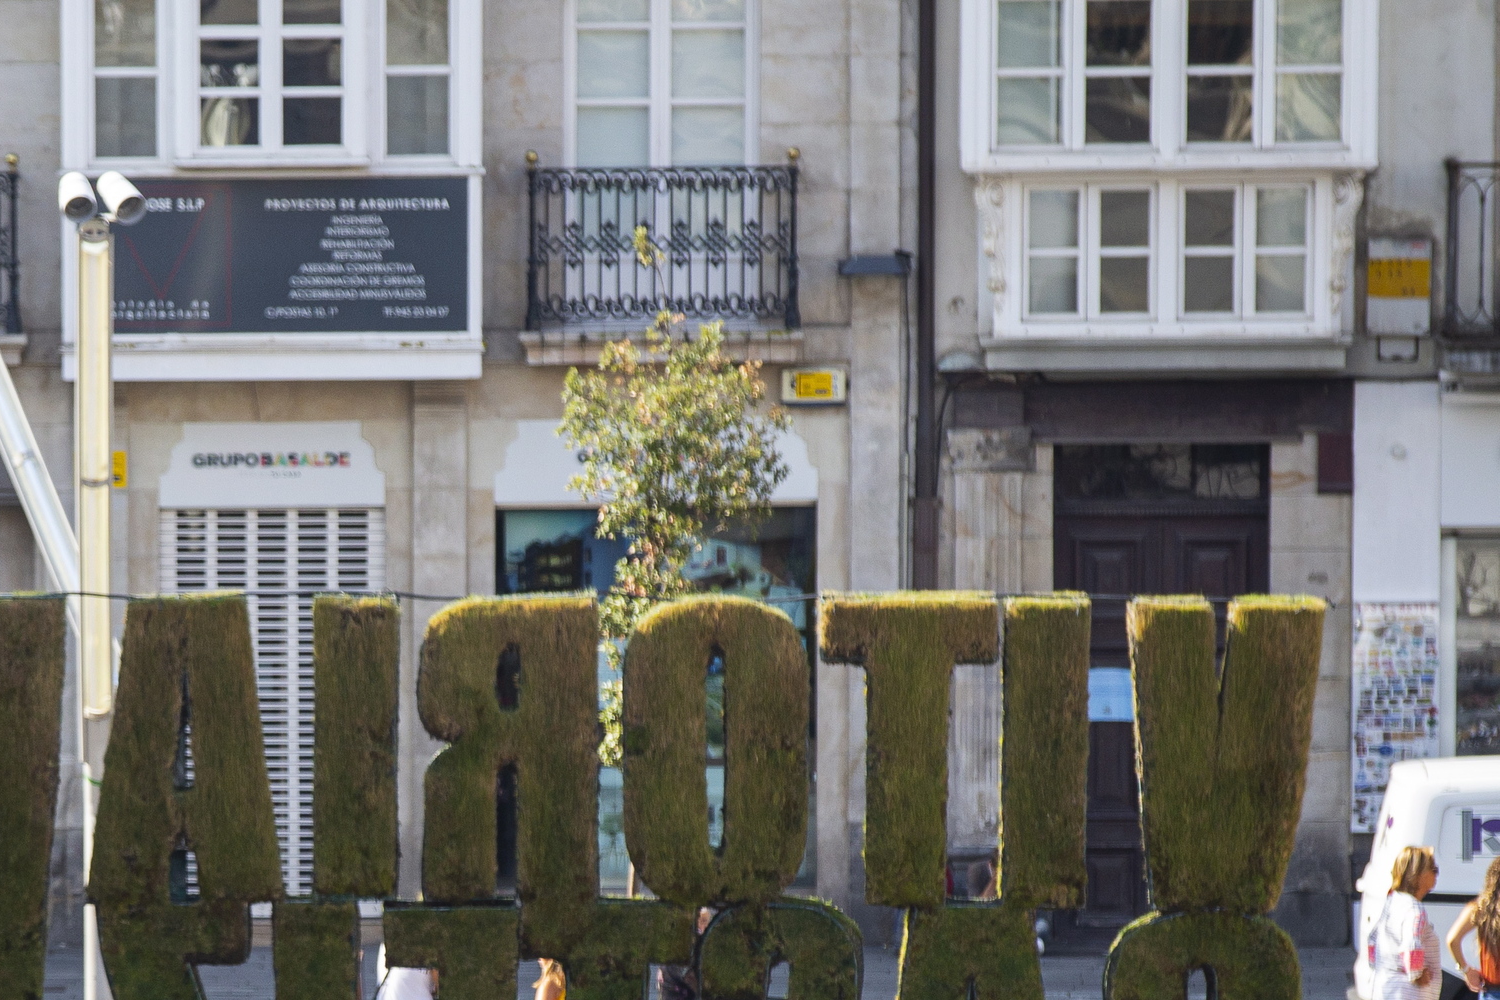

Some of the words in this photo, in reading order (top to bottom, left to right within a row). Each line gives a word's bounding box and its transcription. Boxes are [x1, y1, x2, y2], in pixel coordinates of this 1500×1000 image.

[264, 198, 336, 211] PROYECTOS
[338, 198, 356, 211] DE
[358, 198, 450, 211] ARQUITECTURA
